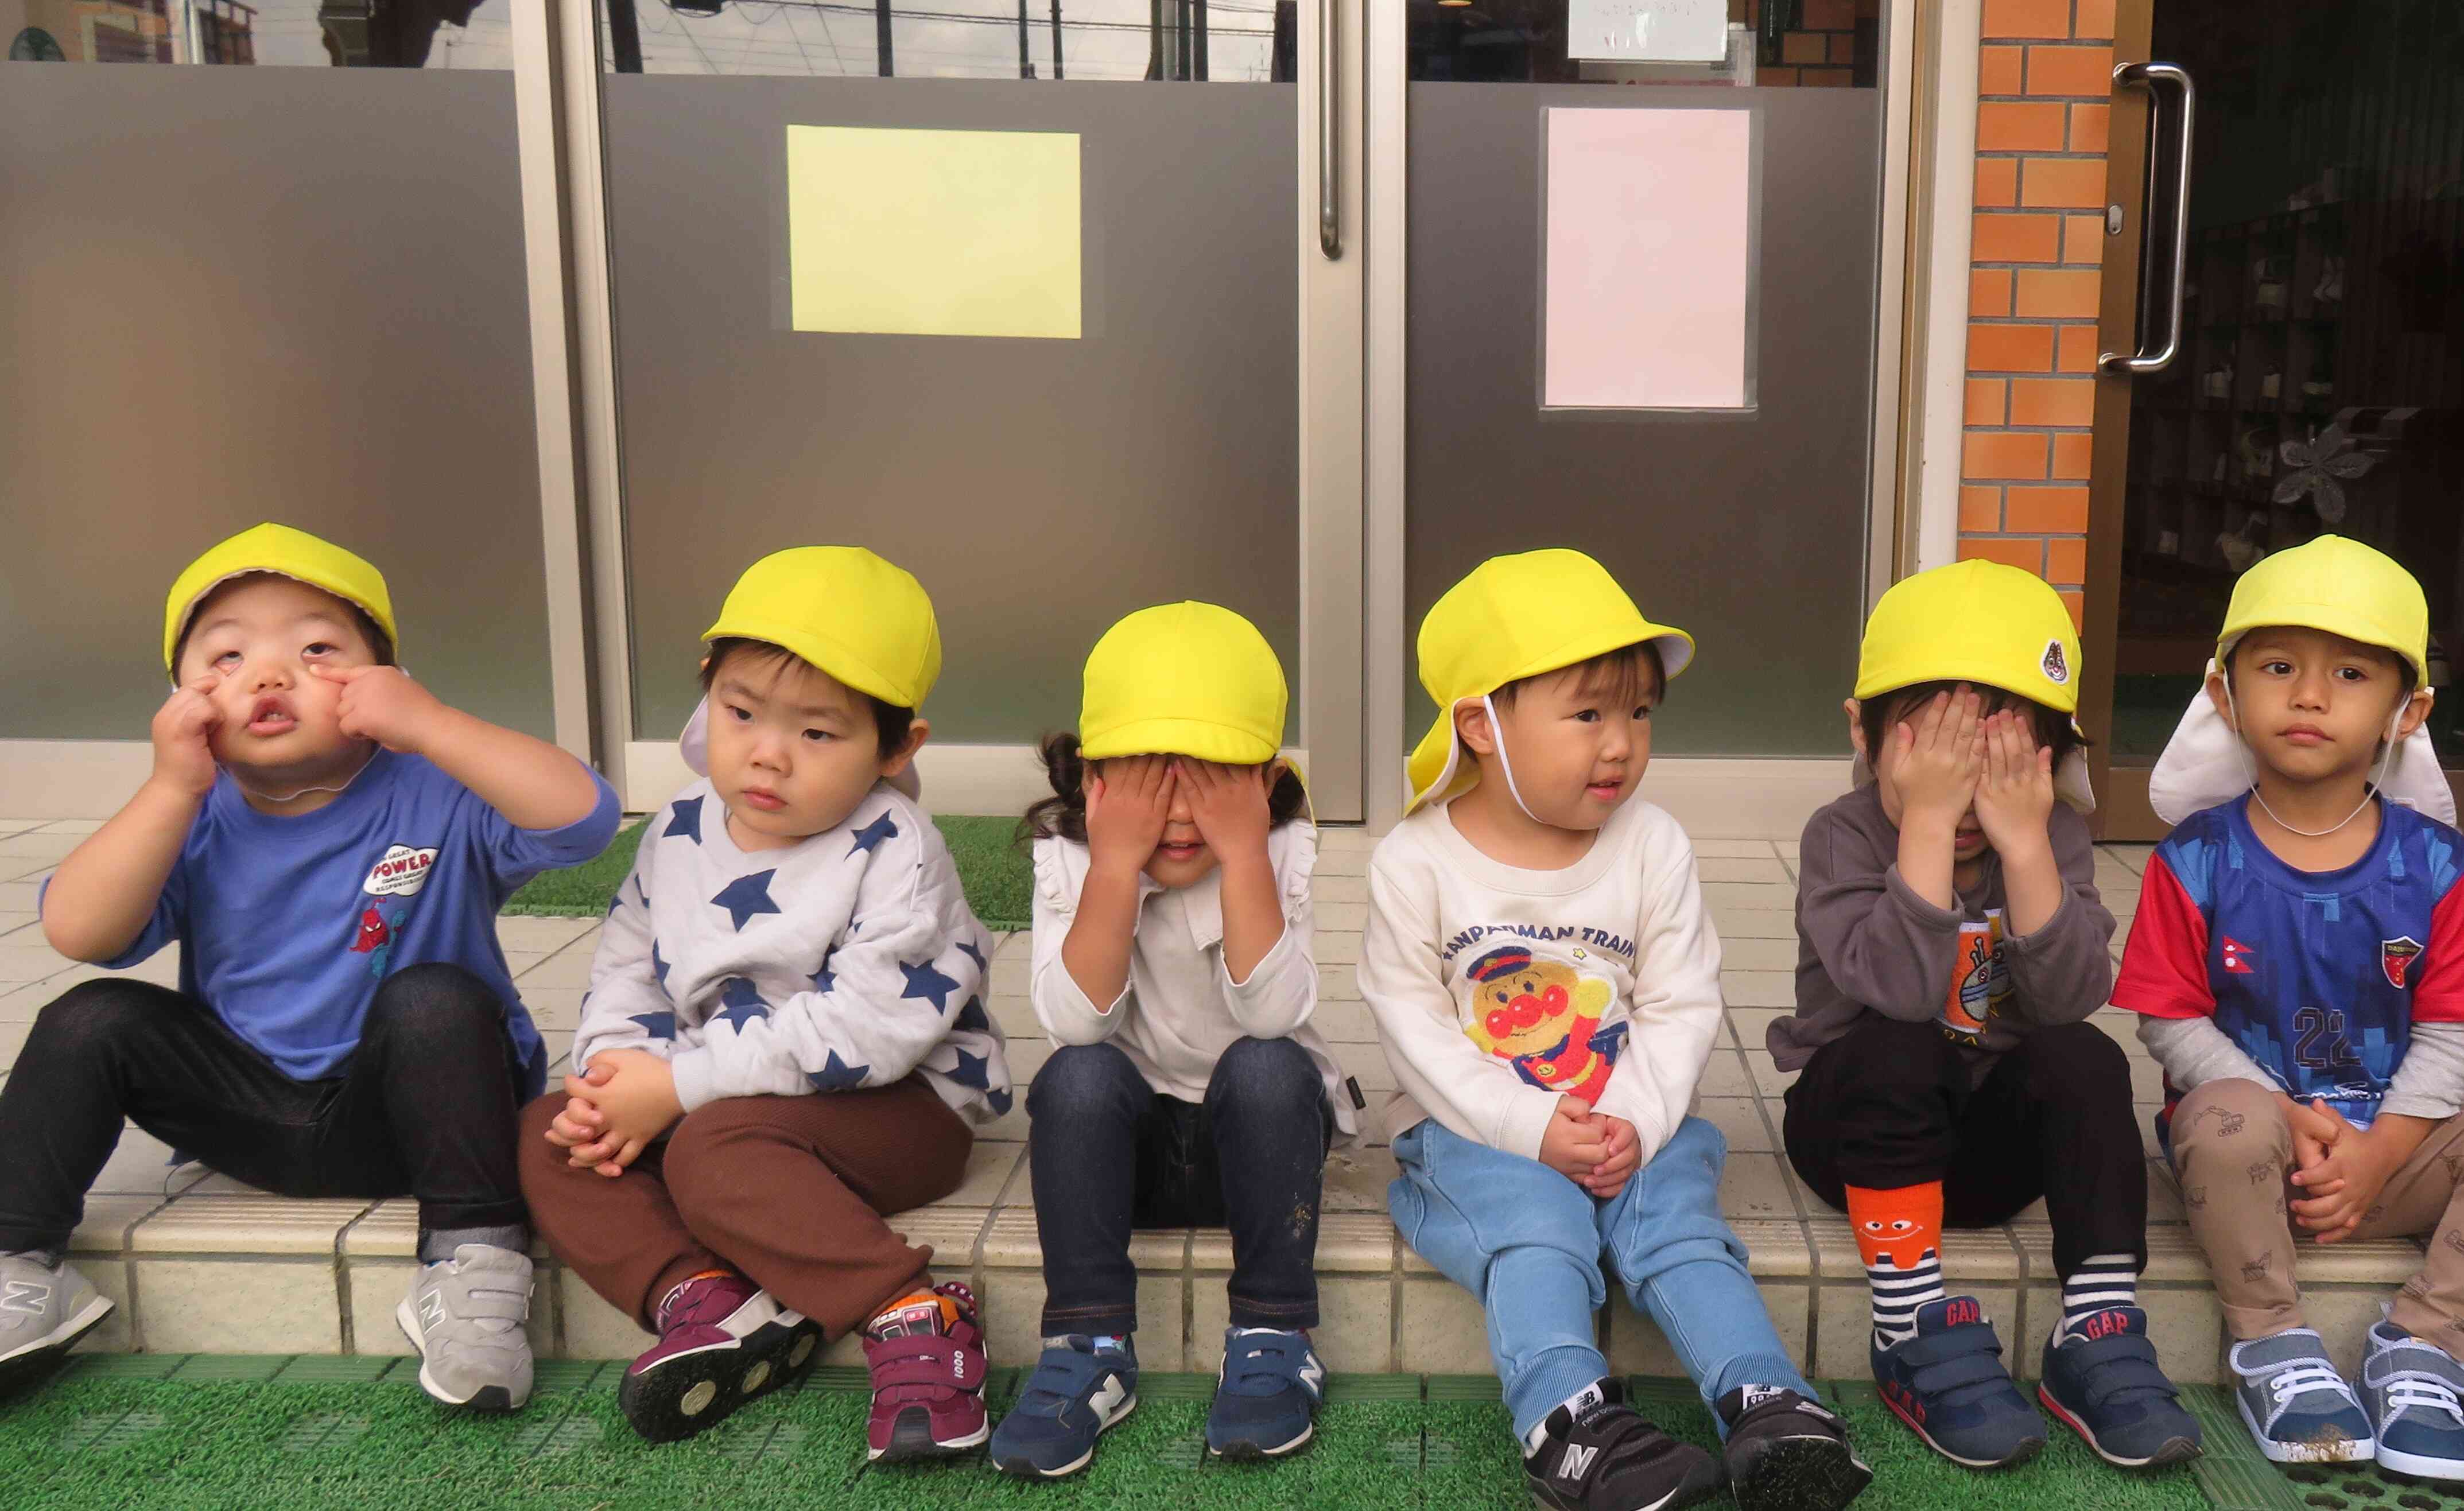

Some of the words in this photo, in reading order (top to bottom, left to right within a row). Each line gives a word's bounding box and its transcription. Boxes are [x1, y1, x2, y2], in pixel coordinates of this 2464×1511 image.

[372, 853, 431, 880] POWER
[2293, 1007, 2363, 1069] 22
[1, 1280, 51, 1314] N
[1947, 1300, 1978, 1327] GAP
[2086, 1311, 2128, 1340] GAP
[954, 1350, 964, 1378] 1000
[1558, 1443, 1599, 1481] N
